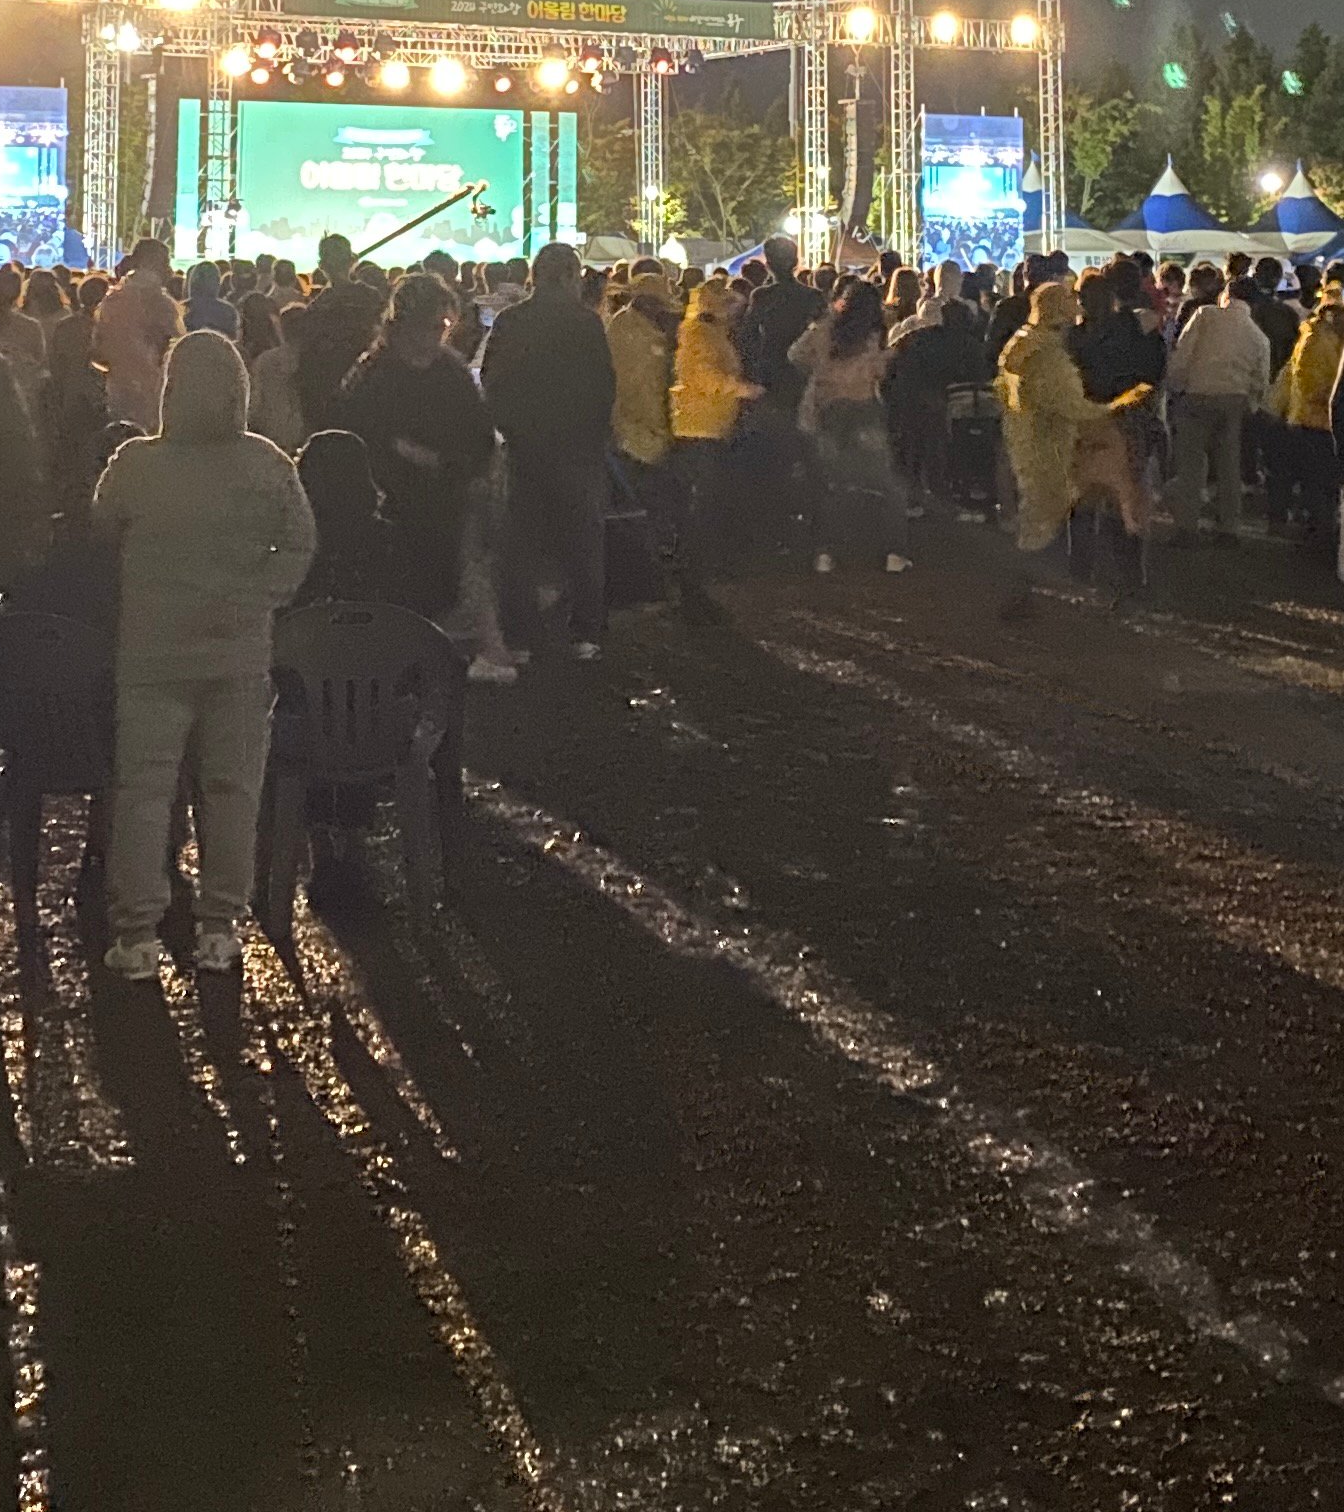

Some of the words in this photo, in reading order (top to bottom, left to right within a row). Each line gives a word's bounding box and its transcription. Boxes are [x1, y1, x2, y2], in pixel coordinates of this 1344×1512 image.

[450, 0, 476, 12] 2024
[526, 0, 576, 21] 어울림
[578, 1, 628, 24] 한마당
